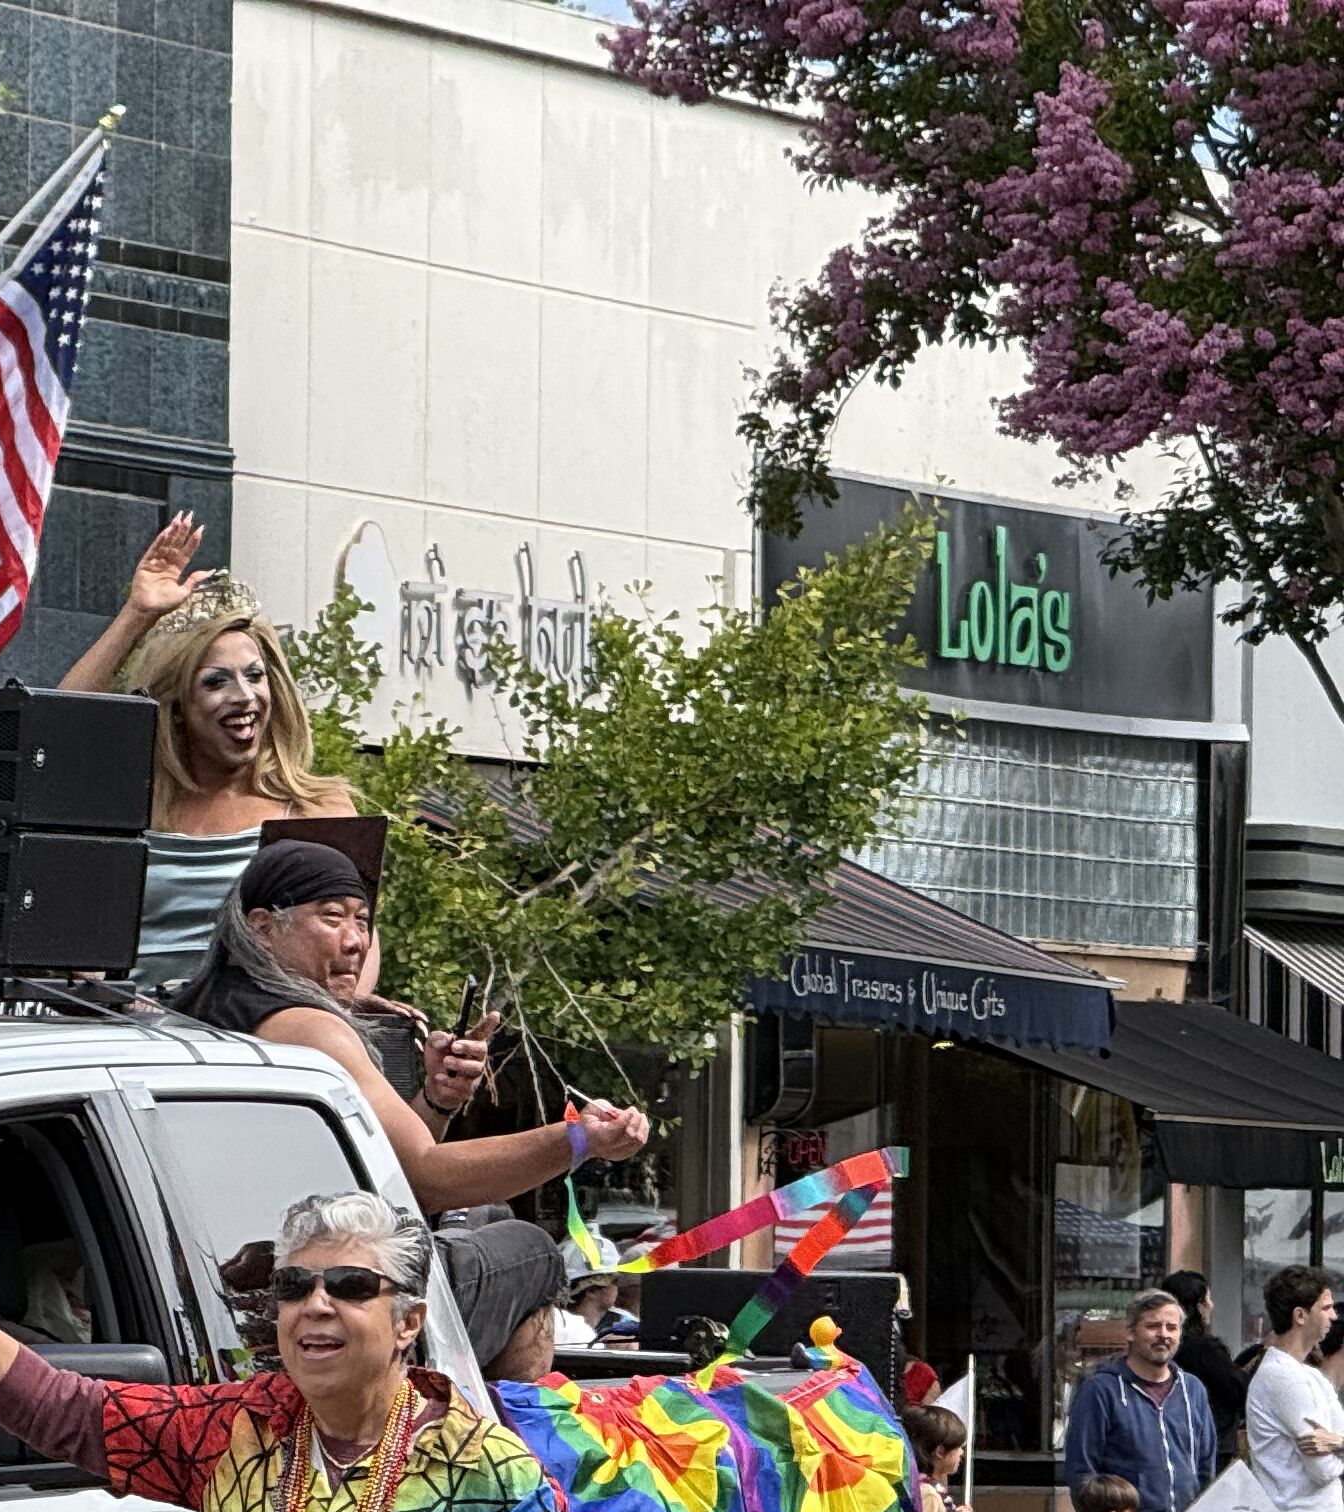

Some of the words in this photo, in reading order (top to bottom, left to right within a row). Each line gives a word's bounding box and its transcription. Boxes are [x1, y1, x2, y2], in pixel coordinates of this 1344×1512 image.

[937, 525, 1072, 673] Lola's
[839, 959, 903, 1004] Treasures
[922, 970, 969, 1027] Unique
